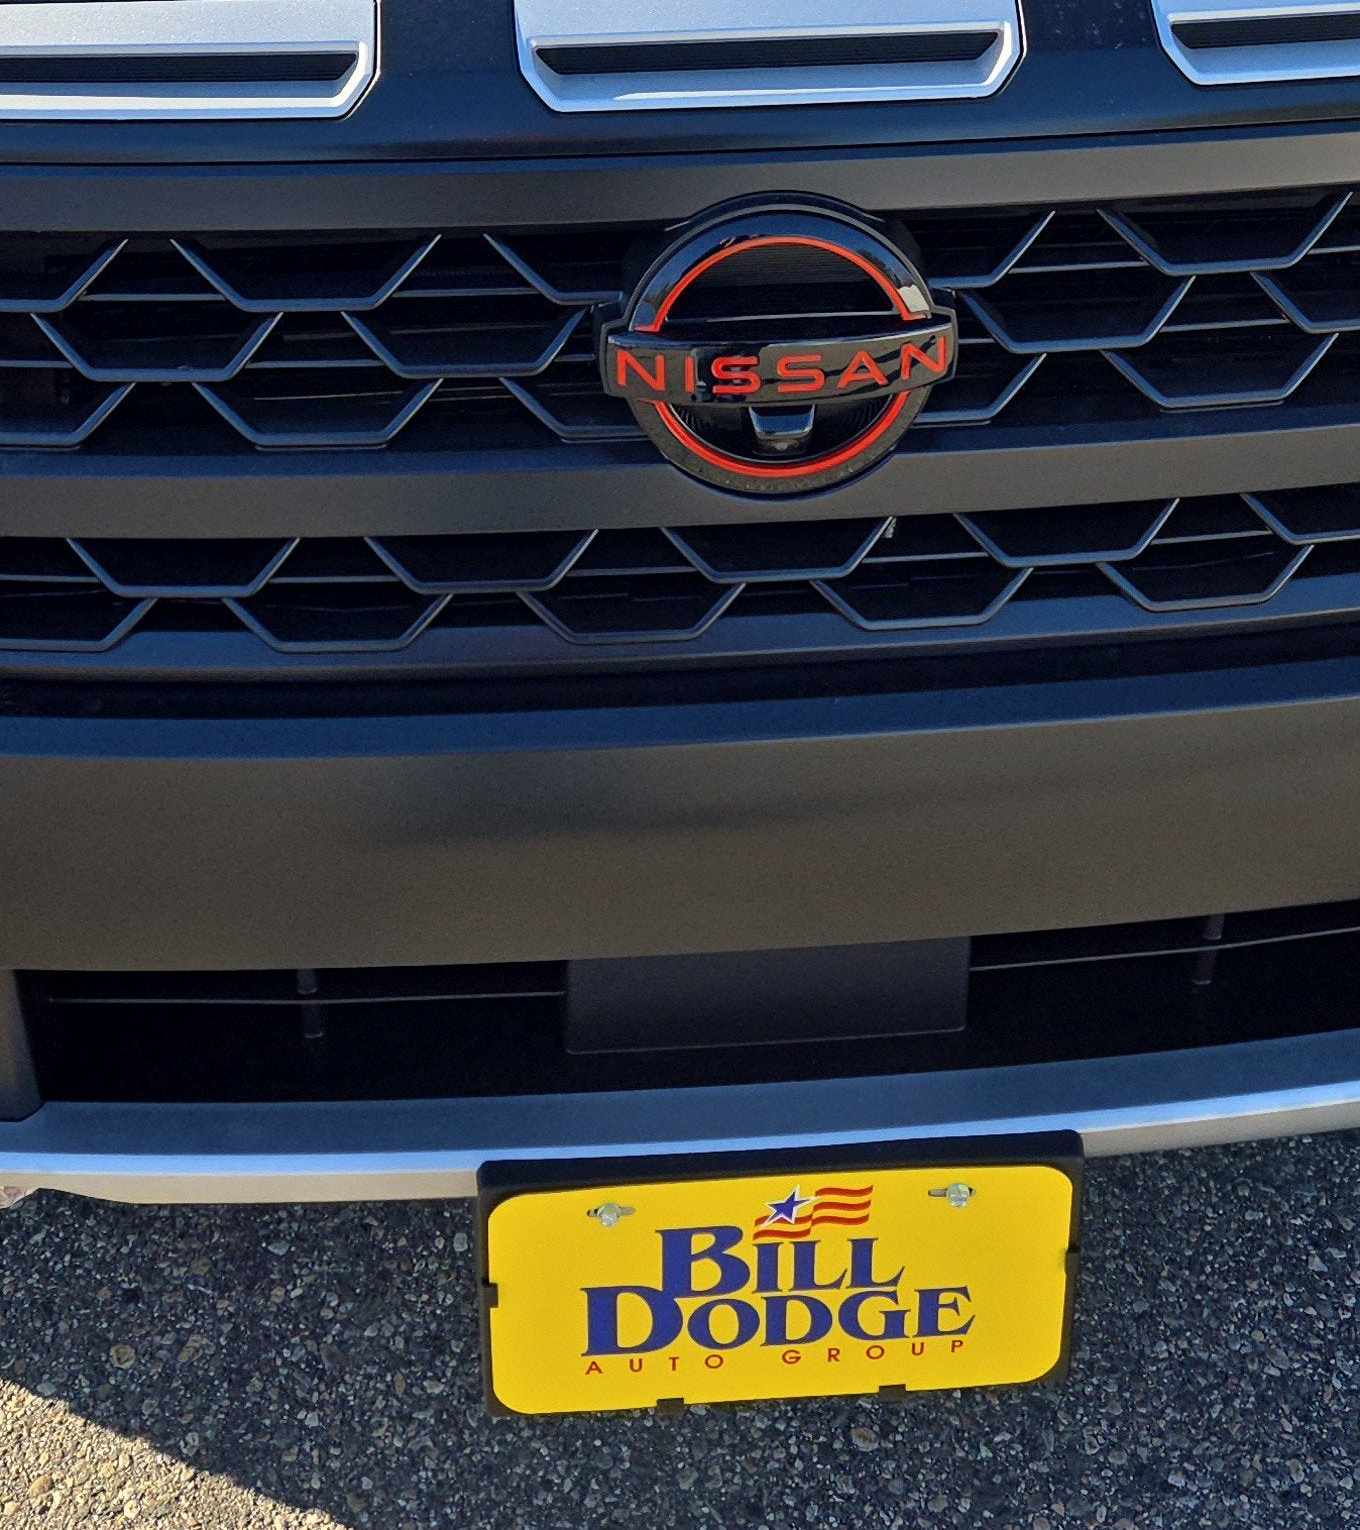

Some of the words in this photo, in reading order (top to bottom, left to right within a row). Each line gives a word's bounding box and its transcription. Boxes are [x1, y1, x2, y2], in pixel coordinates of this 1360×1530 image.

[615, 336, 949, 394] NISSAN
[655, 1224, 905, 1299] BILL
[580, 1285, 976, 1358] DODGE
[585, 1353, 724, 1376] AUTO
[781, 1338, 965, 1365] GROUP
